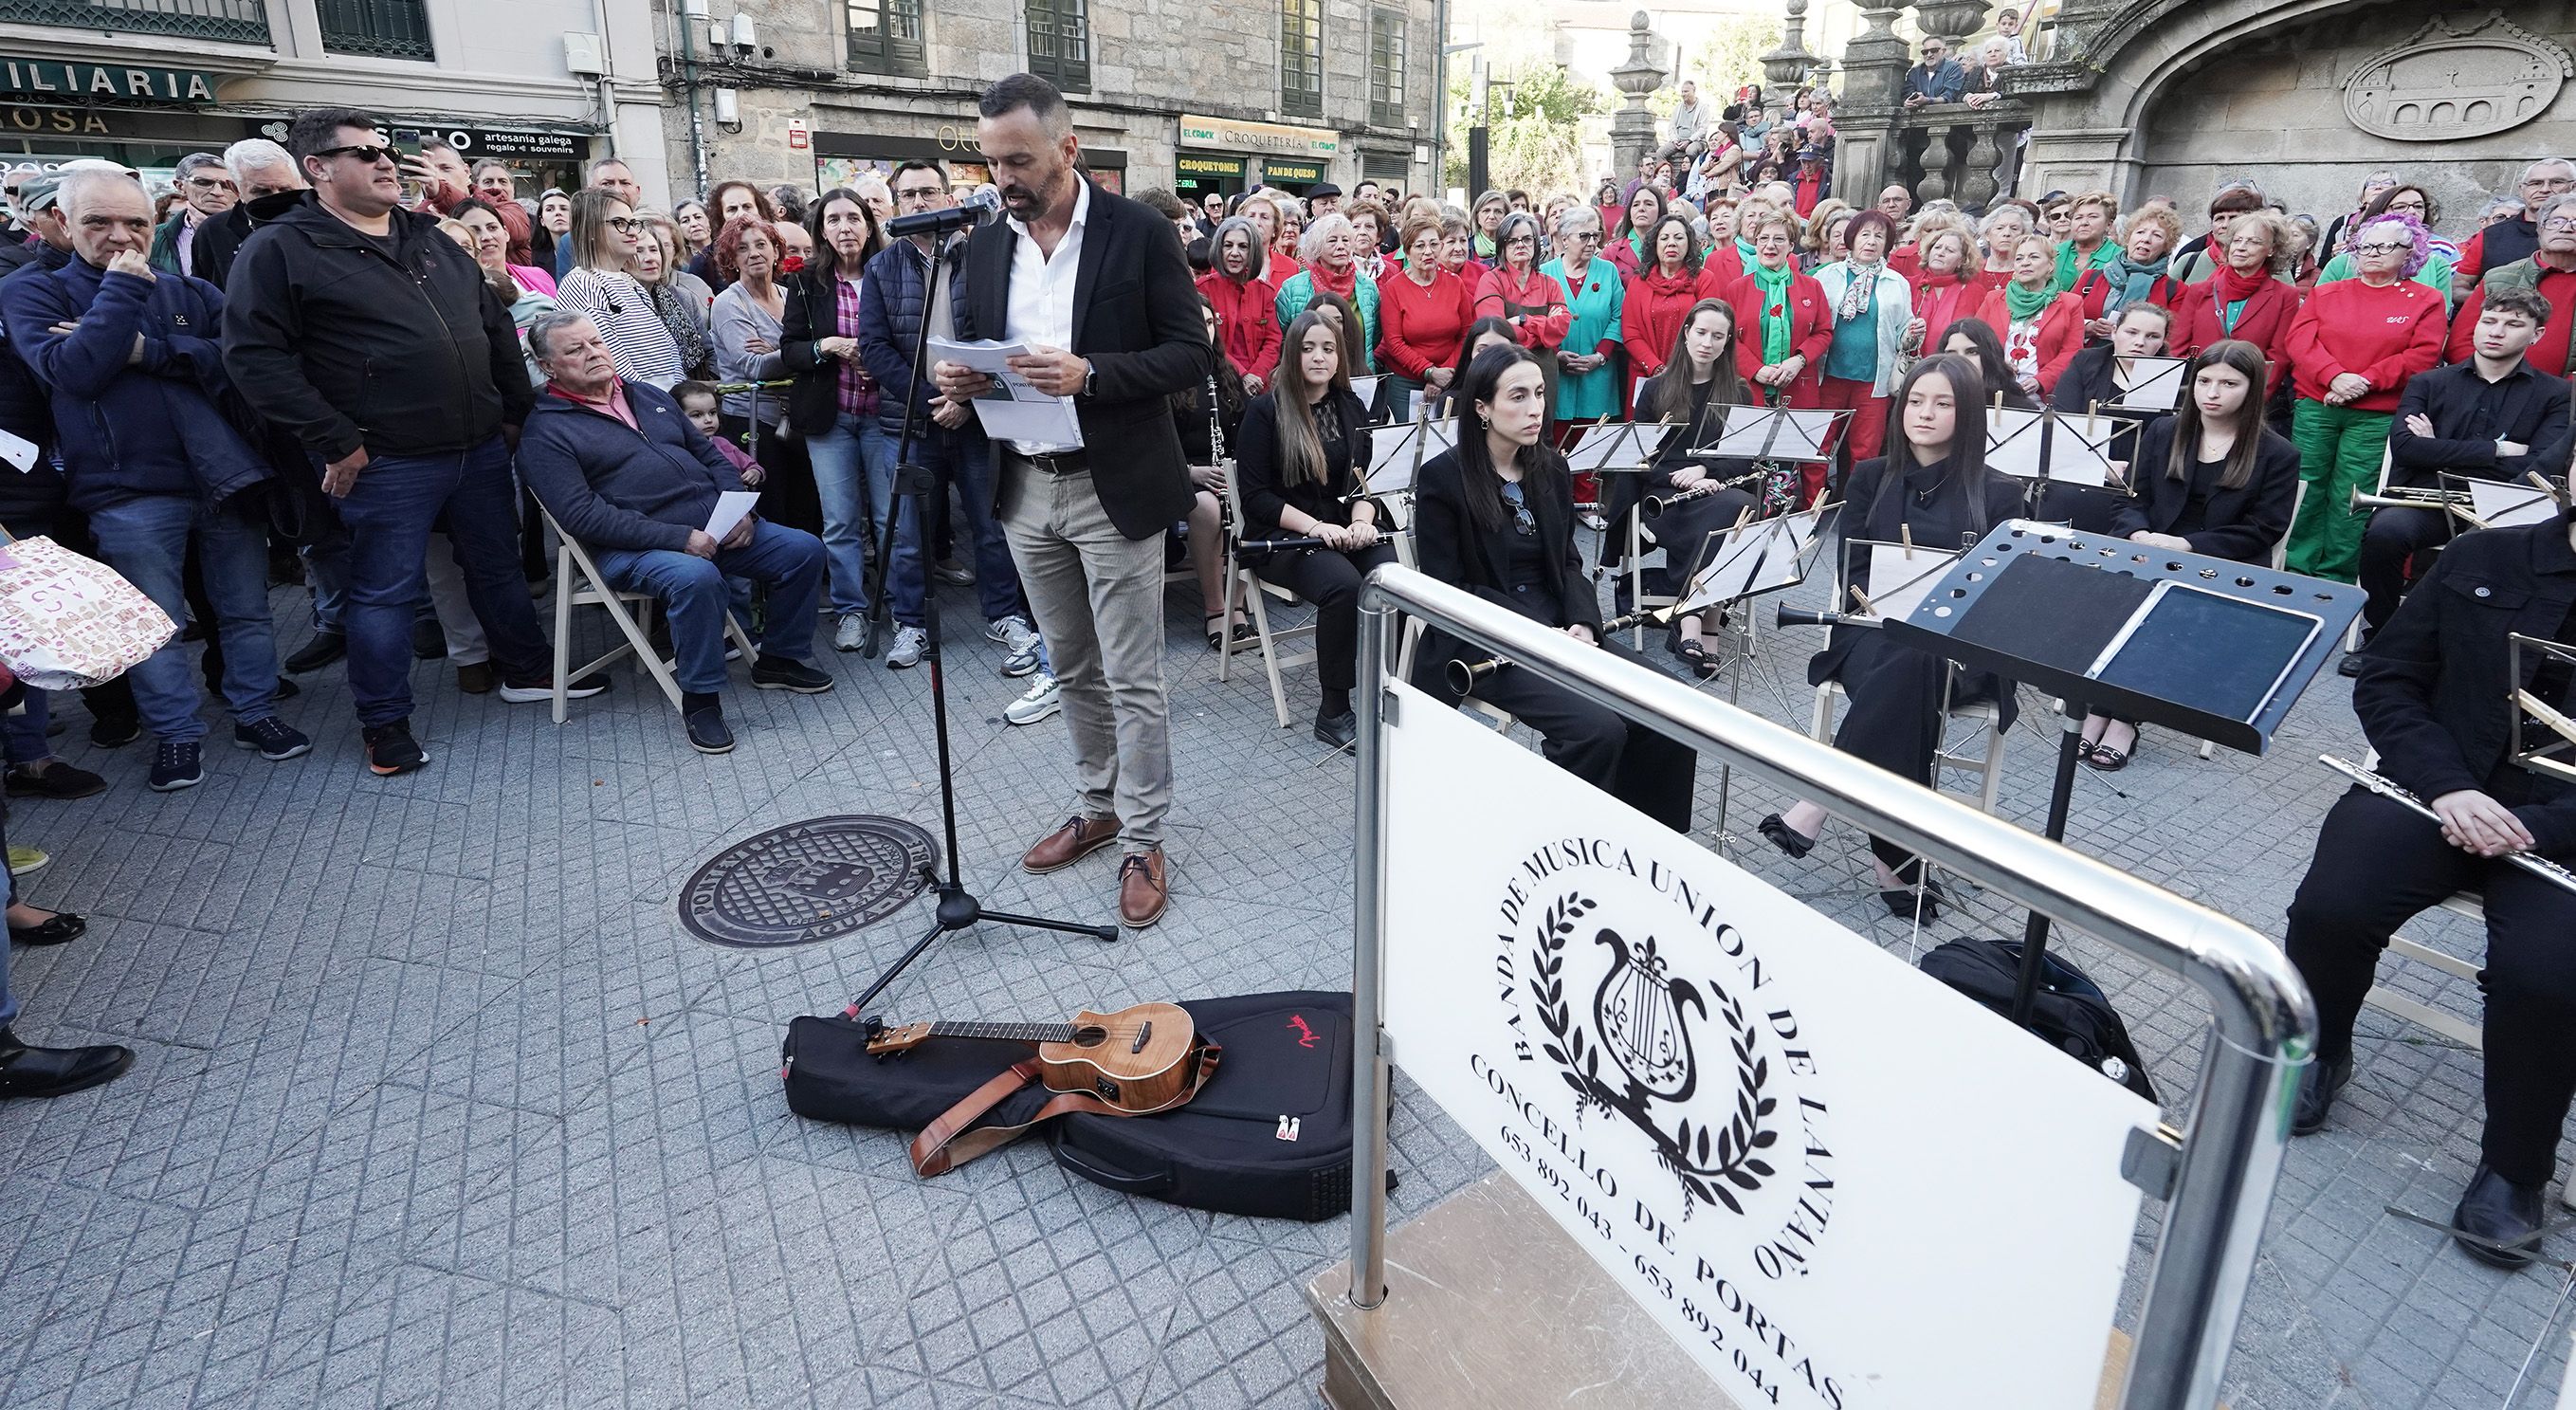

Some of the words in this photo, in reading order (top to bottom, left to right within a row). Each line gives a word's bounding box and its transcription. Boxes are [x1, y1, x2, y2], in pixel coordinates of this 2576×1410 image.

[0, 107, 109, 134] OSA
[484, 133, 536, 143] artesanía
[538, 135, 572, 147] galega
[1183, 129, 1192, 137] EL
[486, 144, 516, 153] regalo
[530, 145, 574, 154] souvenirs
[1179, 159, 1240, 173] CROQUETONES
[1268, 167, 1284, 176] PAN
[1284, 168, 1293, 176] DE
[1293, 168, 1316, 178] QUESO
[1522, 837, 1637, 886] MUSICA
[1500, 877, 1529, 926] DE
[1650, 858, 1773, 990] UNION
[1497, 933, 1534, 1062] BANDA
[1765, 1005, 1818, 1076] DE
[1754, 1092, 1834, 1279] LANTAÑO
[1471, 1053, 1617, 1198] CONCELLO
[1635, 1198, 1675, 1256] DE
[1695, 1254, 1843, 1410] PORTAS
[1501, 1126, 1530, 1163] 653
[1538, 1158, 1569, 1201] 892
[1578, 1196, 1612, 1240] 043
[1635, 1254, 1672, 1300] 653
[1681, 1297, 1723, 1351] 892
[1733, 1348, 1779, 1405] 044
